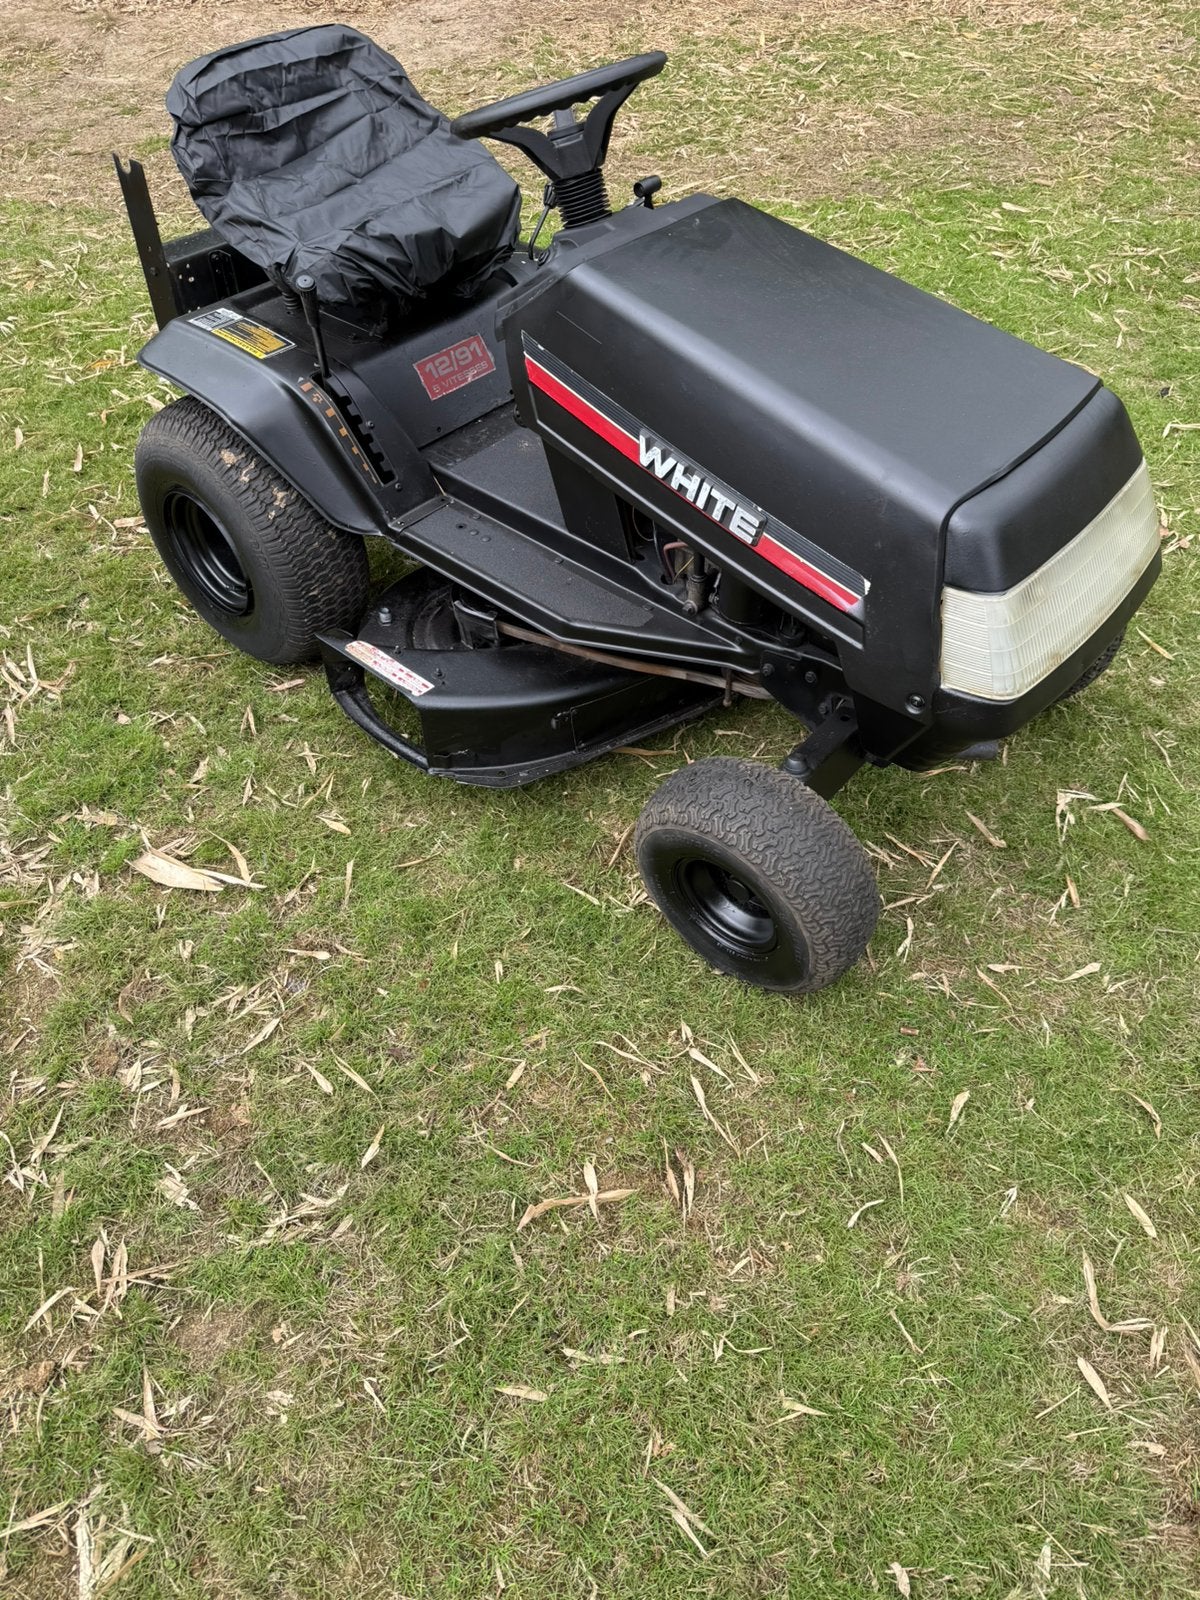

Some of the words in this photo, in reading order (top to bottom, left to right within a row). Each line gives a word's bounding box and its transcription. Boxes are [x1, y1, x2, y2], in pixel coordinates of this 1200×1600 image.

[424, 341, 483, 379] 12/91
[432, 384, 441, 393] 5
[441, 360, 489, 388] VITESSES
[639, 434, 760, 544] WHITE
